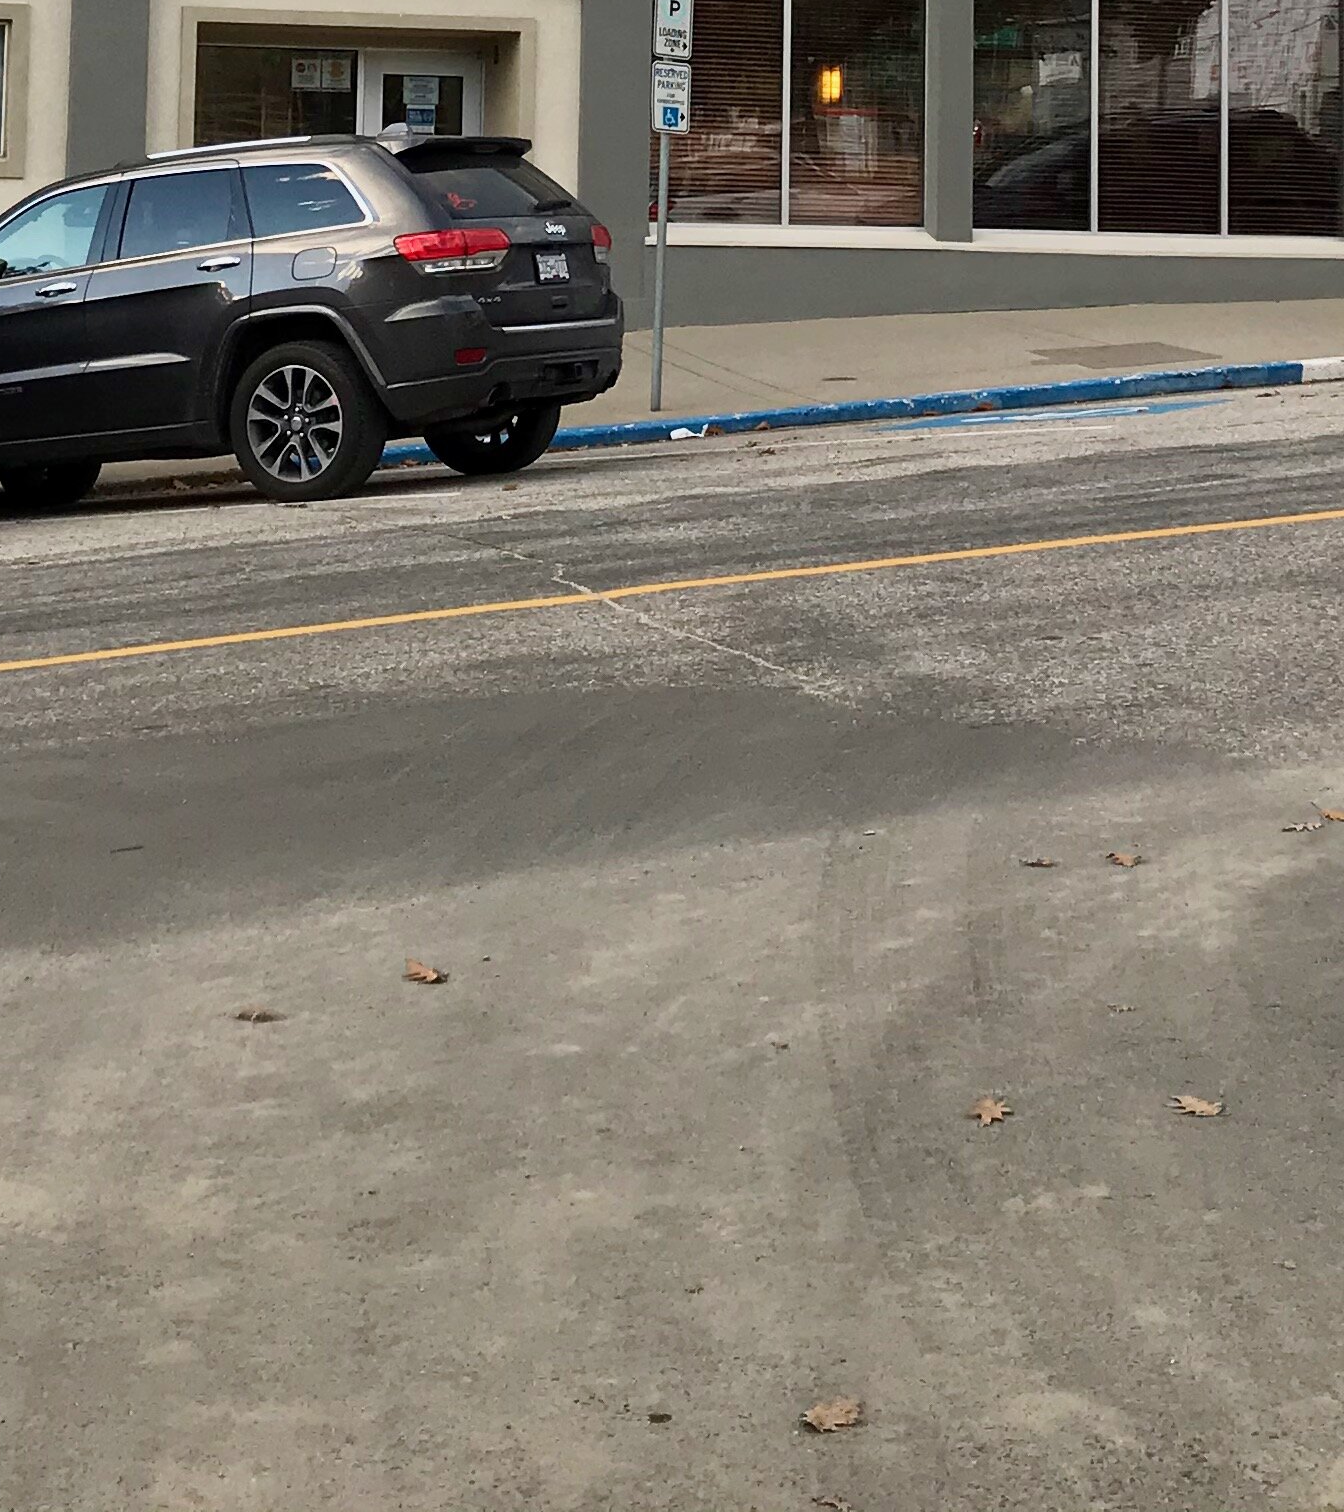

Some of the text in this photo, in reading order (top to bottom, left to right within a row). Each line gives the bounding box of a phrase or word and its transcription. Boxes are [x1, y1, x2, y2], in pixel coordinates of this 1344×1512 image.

[669, 0, 681, 17] P
[658, 27, 688, 40] LOADING
[663, 38, 681, 48] ZONE
[655, 68, 688, 80] RESERVED
[657, 79, 686, 92] PARKING
[544, 221, 567, 236] Jeep
